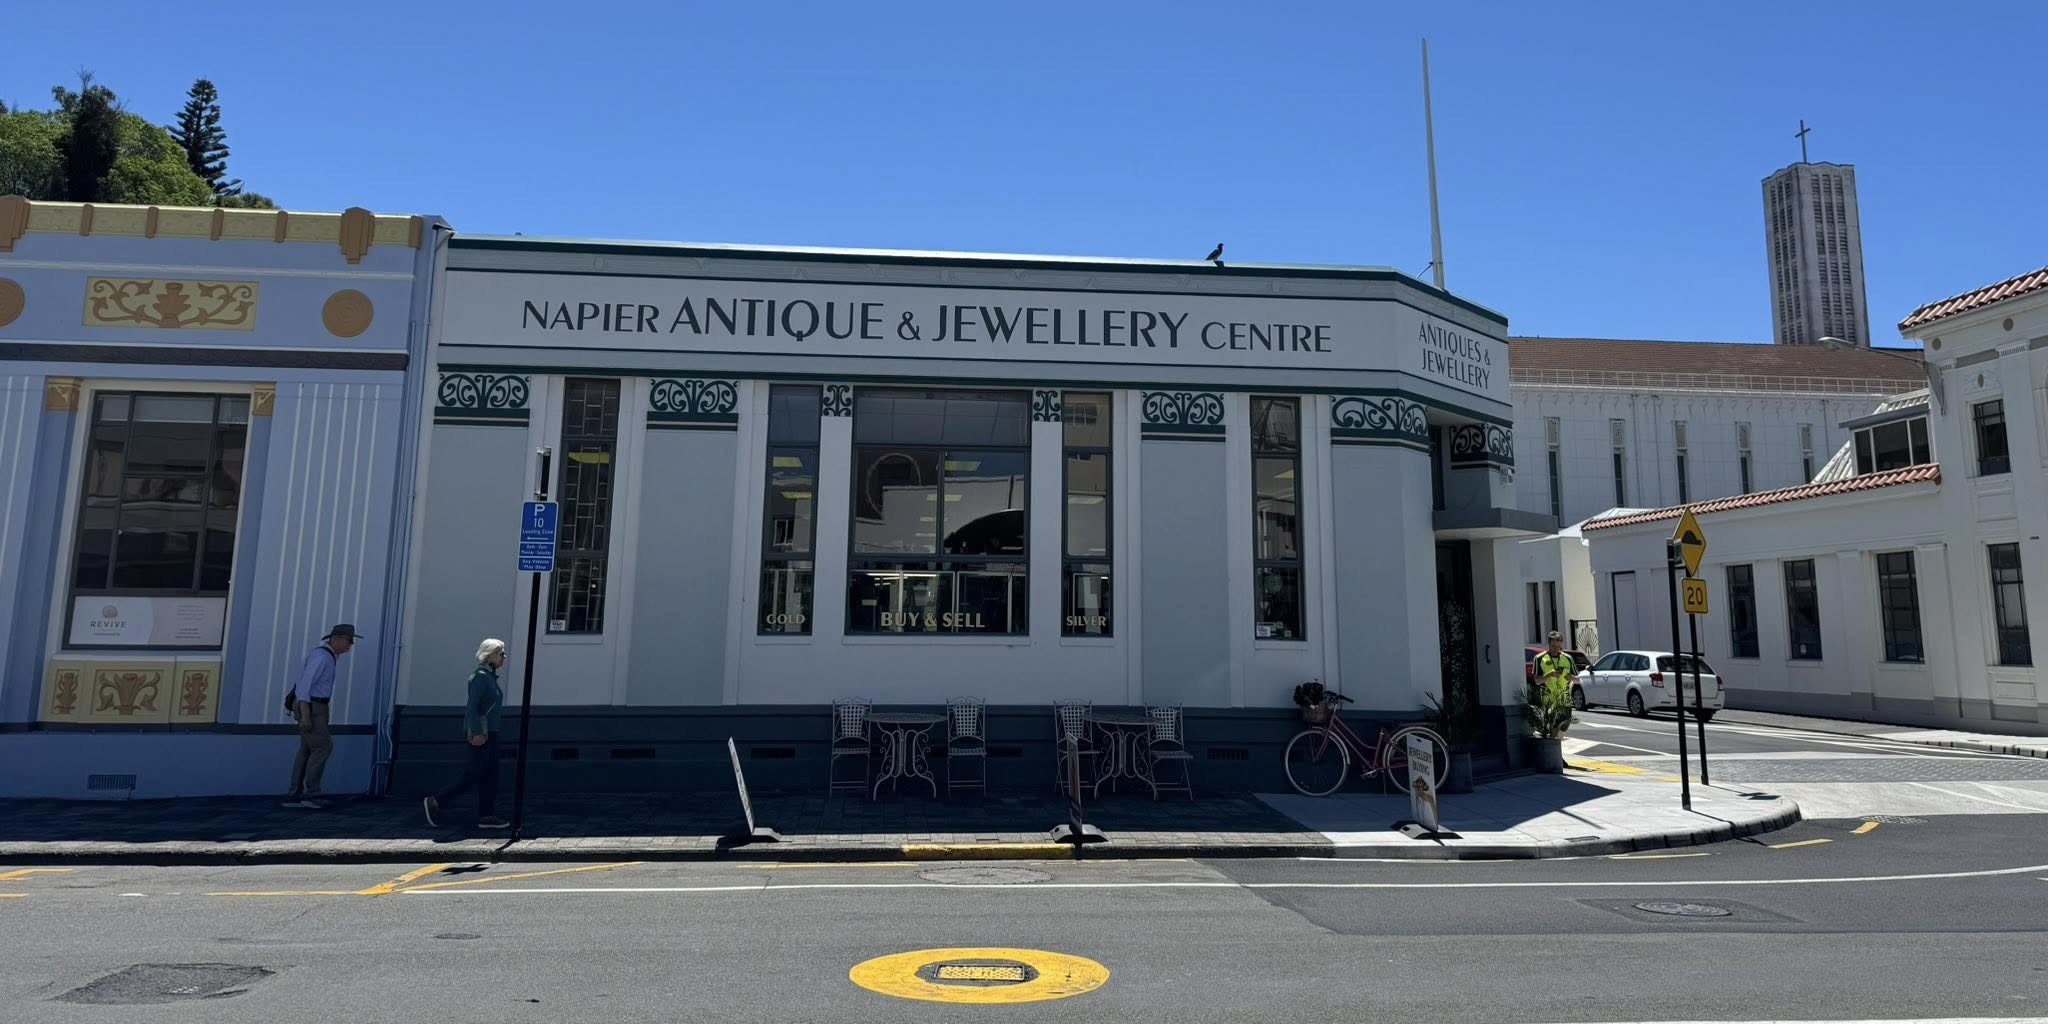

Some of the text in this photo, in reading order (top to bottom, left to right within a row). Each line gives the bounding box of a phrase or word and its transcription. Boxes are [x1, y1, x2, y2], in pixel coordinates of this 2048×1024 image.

[522, 296, 1332, 353] NAPIER ANTIQUE & JEWELLERY CENTRE
[1419, 321, 1491, 366] ANTIQUES &
[1422, 348, 1490, 390] JEWELLERY
[534, 503, 546, 516] P
[534, 517, 544, 528] 10
[1687, 586, 1704, 606] 20
[90, 620, 127, 628] REVIVE
[766, 613, 806, 625] GOLD
[880, 611, 986, 628] BUY & SELL
[1066, 615, 1107, 627] SILVER
